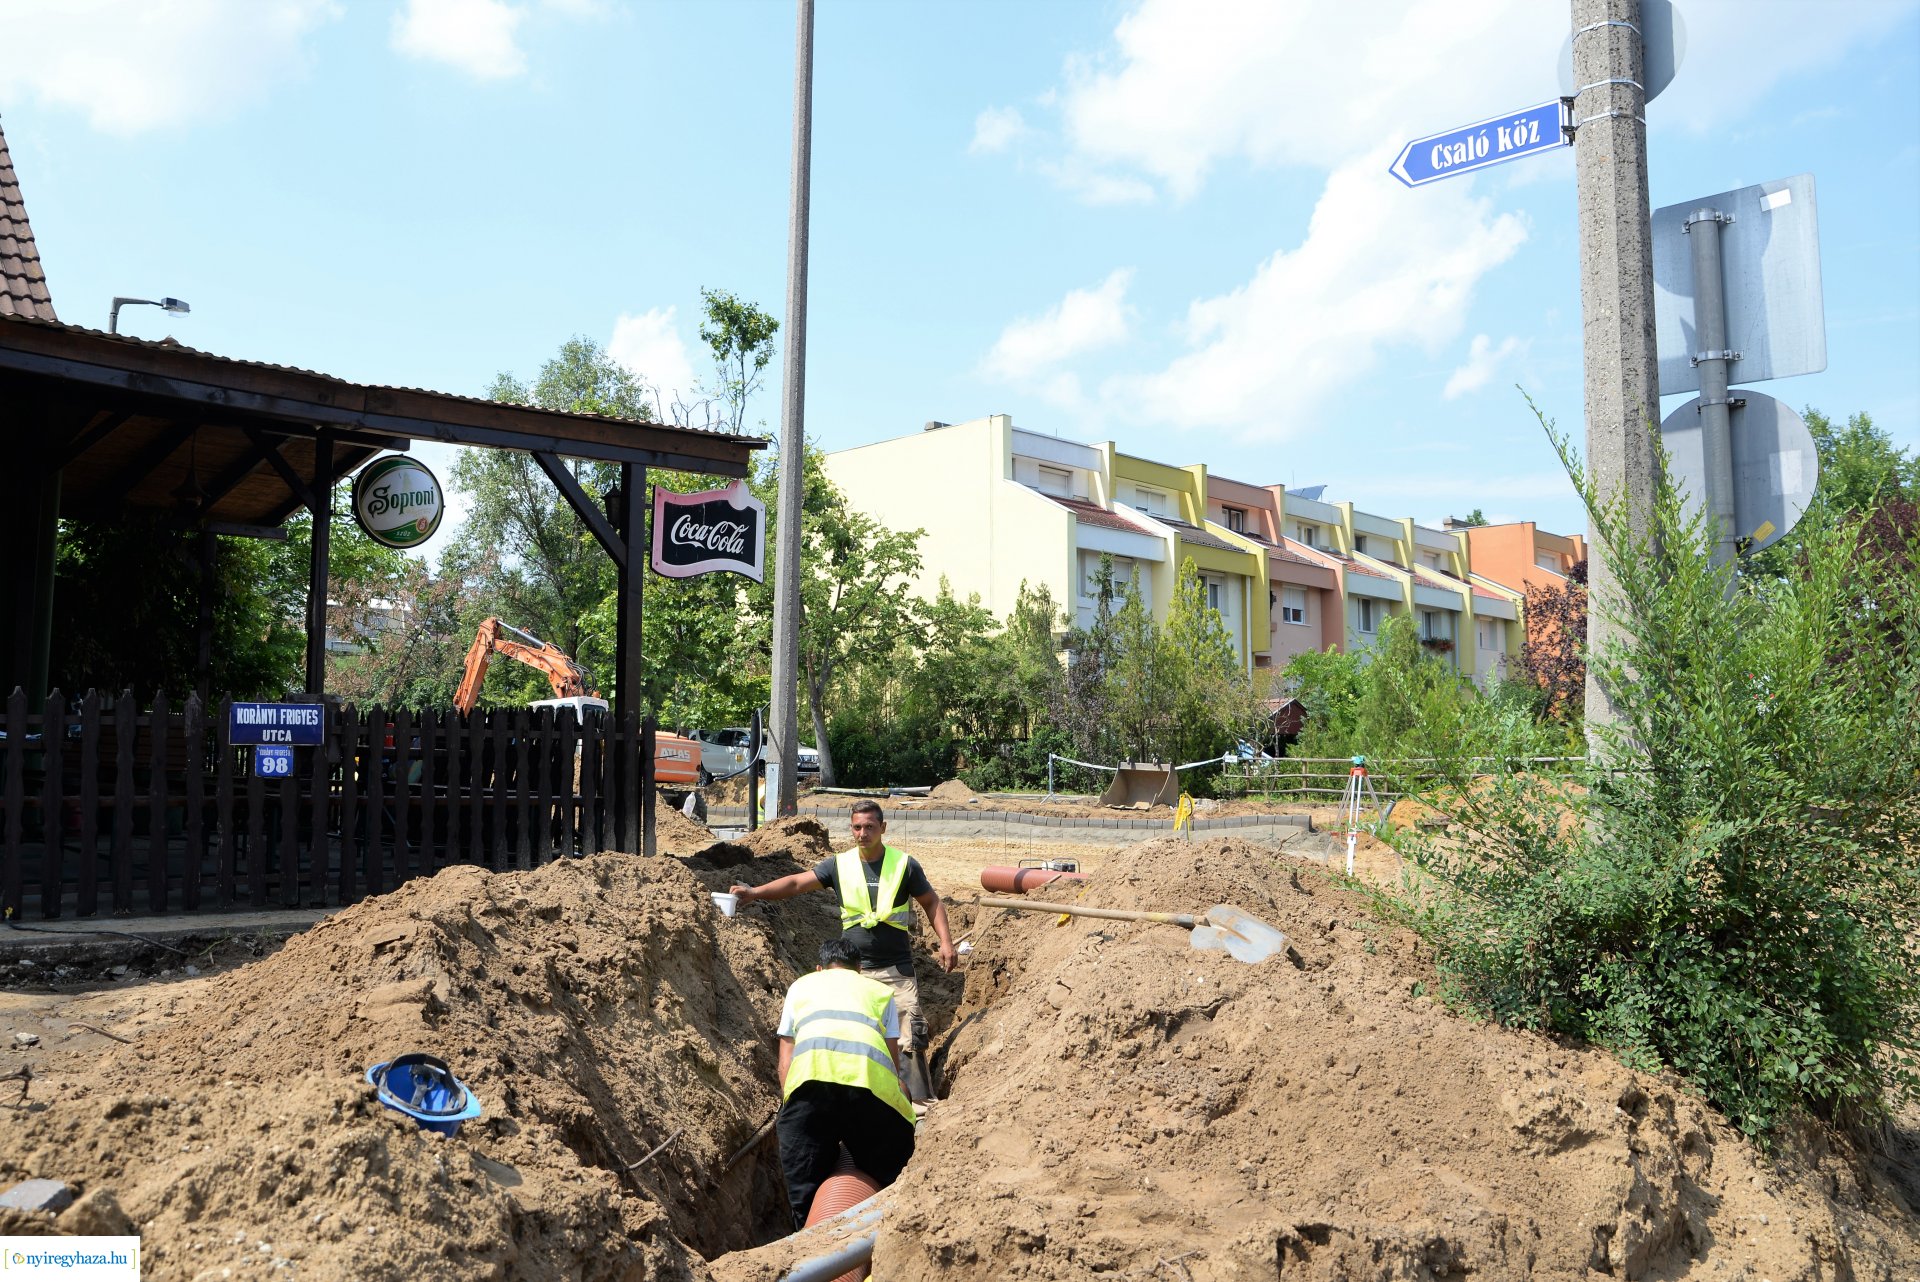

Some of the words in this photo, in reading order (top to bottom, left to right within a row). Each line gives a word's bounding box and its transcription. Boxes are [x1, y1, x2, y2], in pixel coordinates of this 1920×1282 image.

[1431, 129, 1489, 170] Csaló
[1497, 118, 1540, 153] köz
[368, 484, 434, 518] Soproni
[670, 514, 750, 554] Coca-Cola
[237, 705, 276, 725] KORÁNYI
[281, 708, 318, 725] FRIGYES
[262, 729, 292, 742] UTCA
[660, 747, 690, 760] ATLAS
[262, 757, 288, 774] 98
